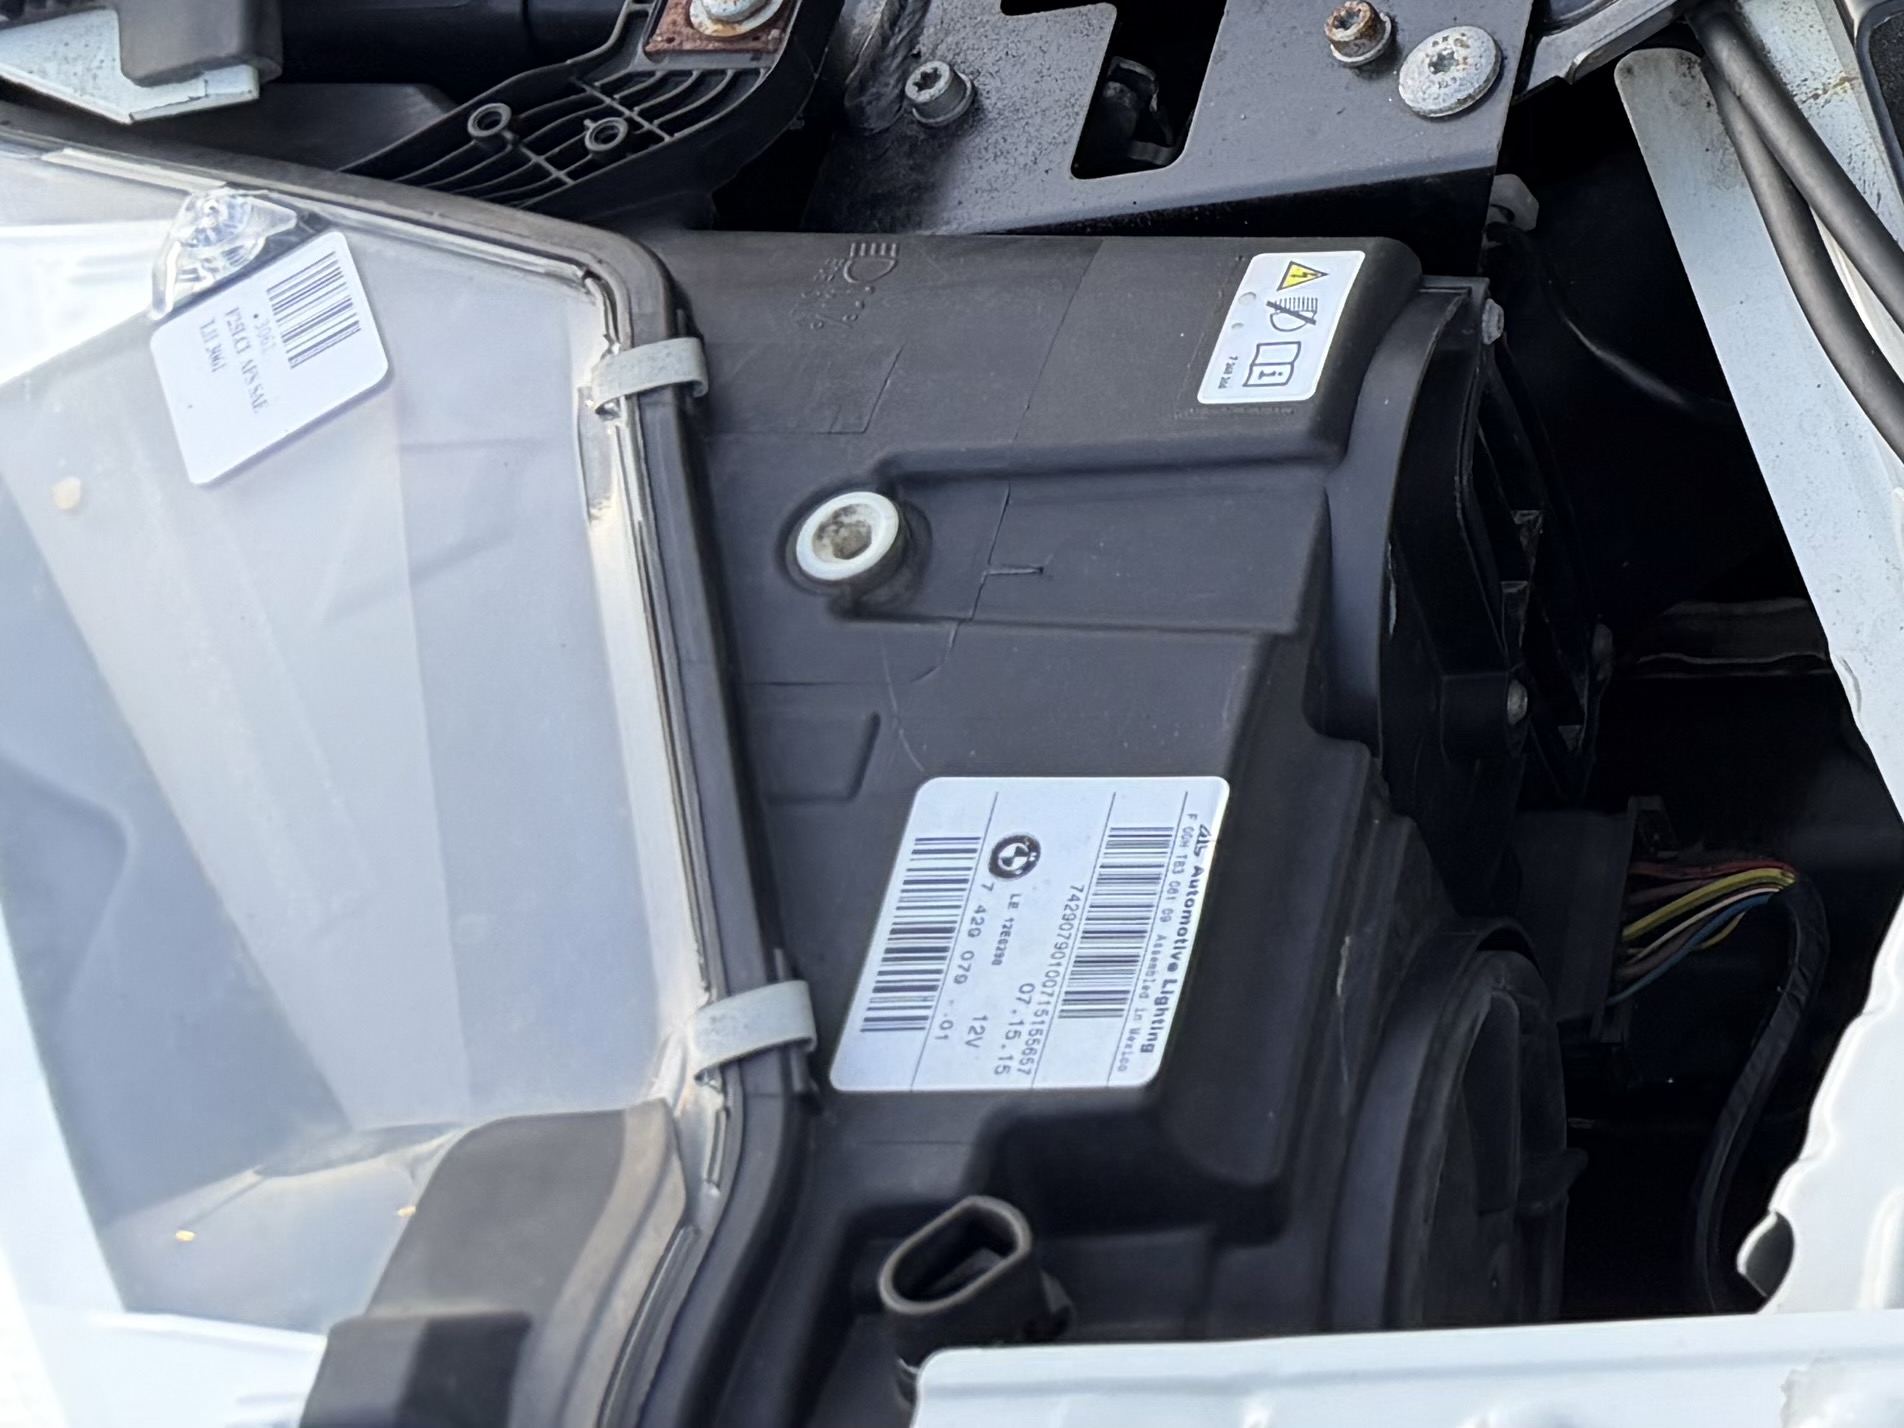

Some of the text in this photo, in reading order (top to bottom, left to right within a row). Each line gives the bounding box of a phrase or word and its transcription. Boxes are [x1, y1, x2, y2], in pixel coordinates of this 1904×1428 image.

[1165, 865, 1206, 972] Automotive
[952, 950, 974, 984] 079
[1136, 934, 1168, 999] Assembled
[963, 1015, 989, 1048] 12V
[992, 982, 1036, 1074] 07.15.15
[1139, 978, 1177, 1053] Lighting
[1115, 1028, 1141, 1071] Mexico
